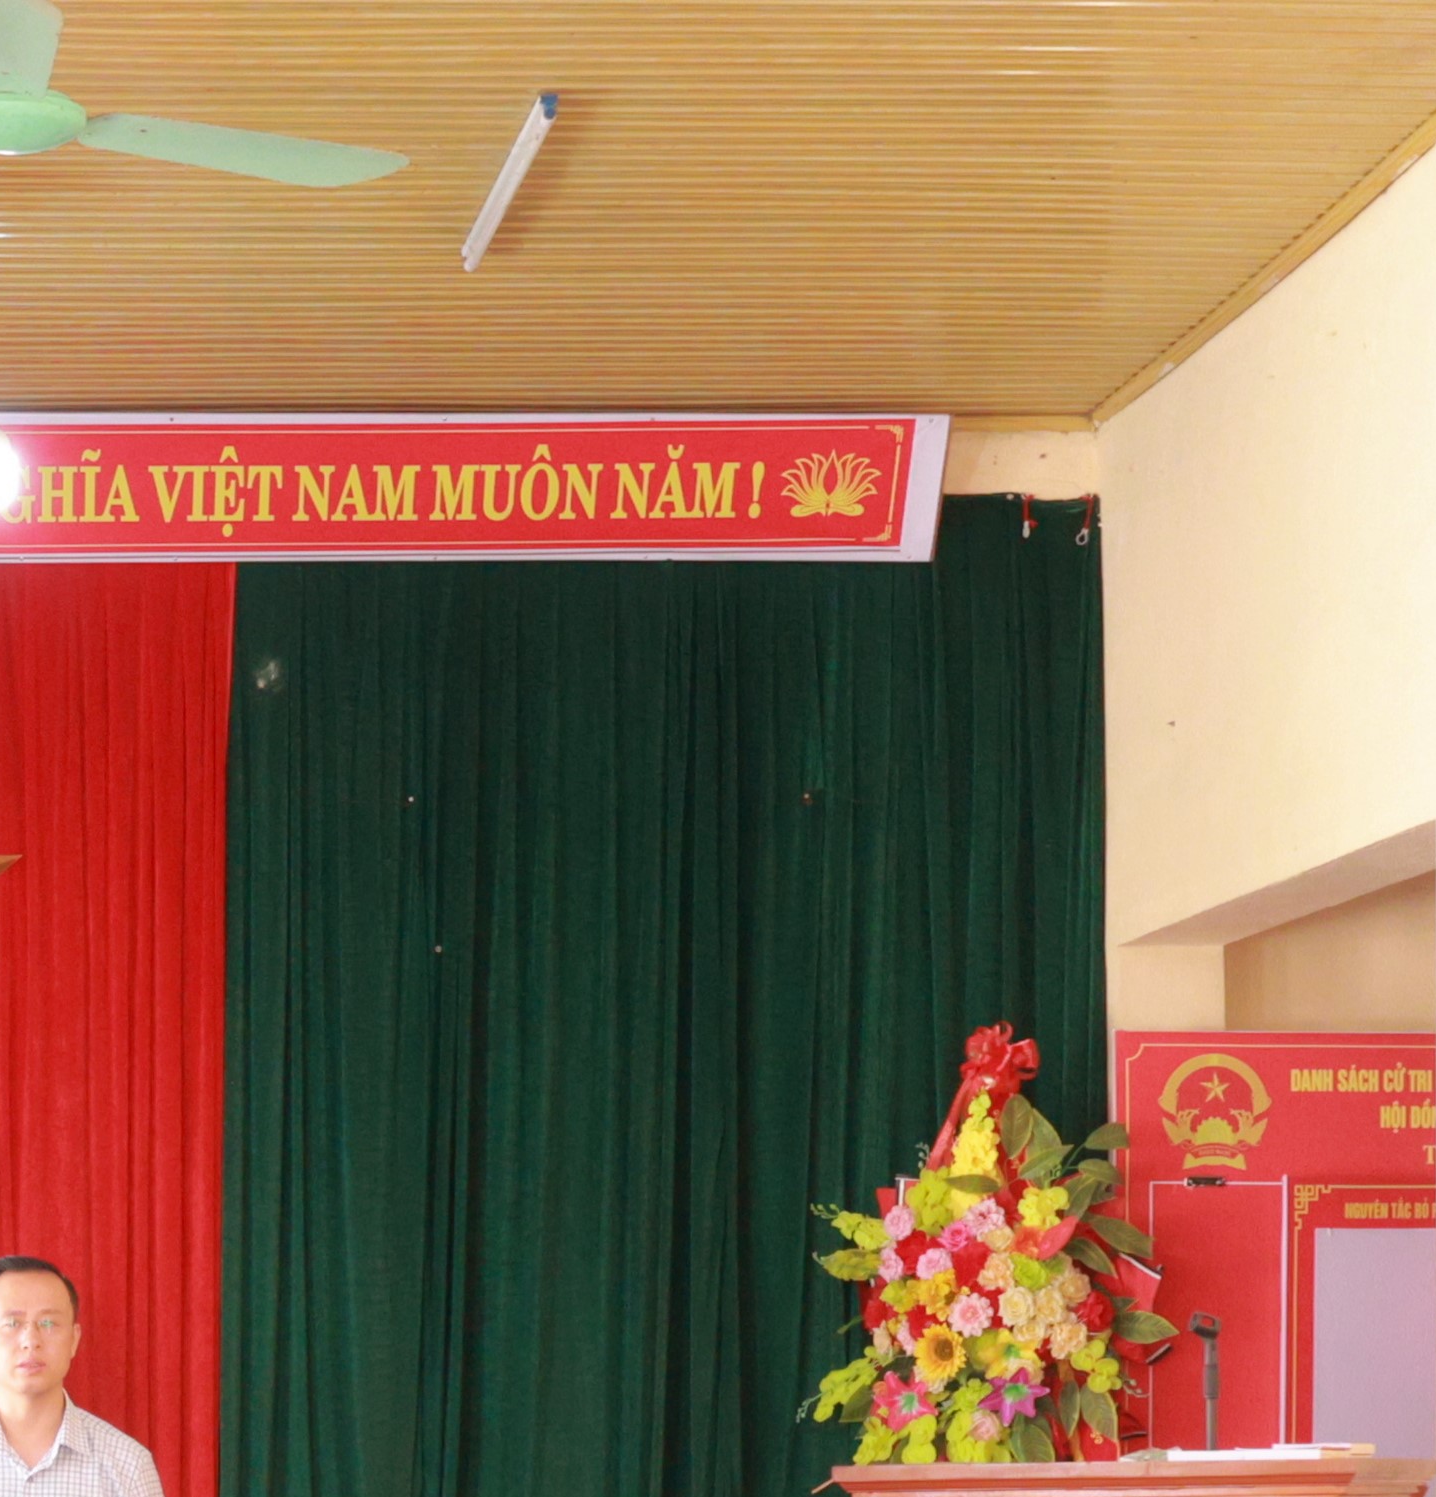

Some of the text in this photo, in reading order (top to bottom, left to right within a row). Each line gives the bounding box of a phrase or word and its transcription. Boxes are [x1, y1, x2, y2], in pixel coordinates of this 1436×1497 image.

[148, 446, 282, 537] VIỆT
[292, 464, 421, 521] NAM
[429, 444, 603, 520] MUÔN
[1291, 1062, 1432, 1092] DANH SÁCH CỬ TRI
[1380, 1101, 1406, 1133] HỘI
